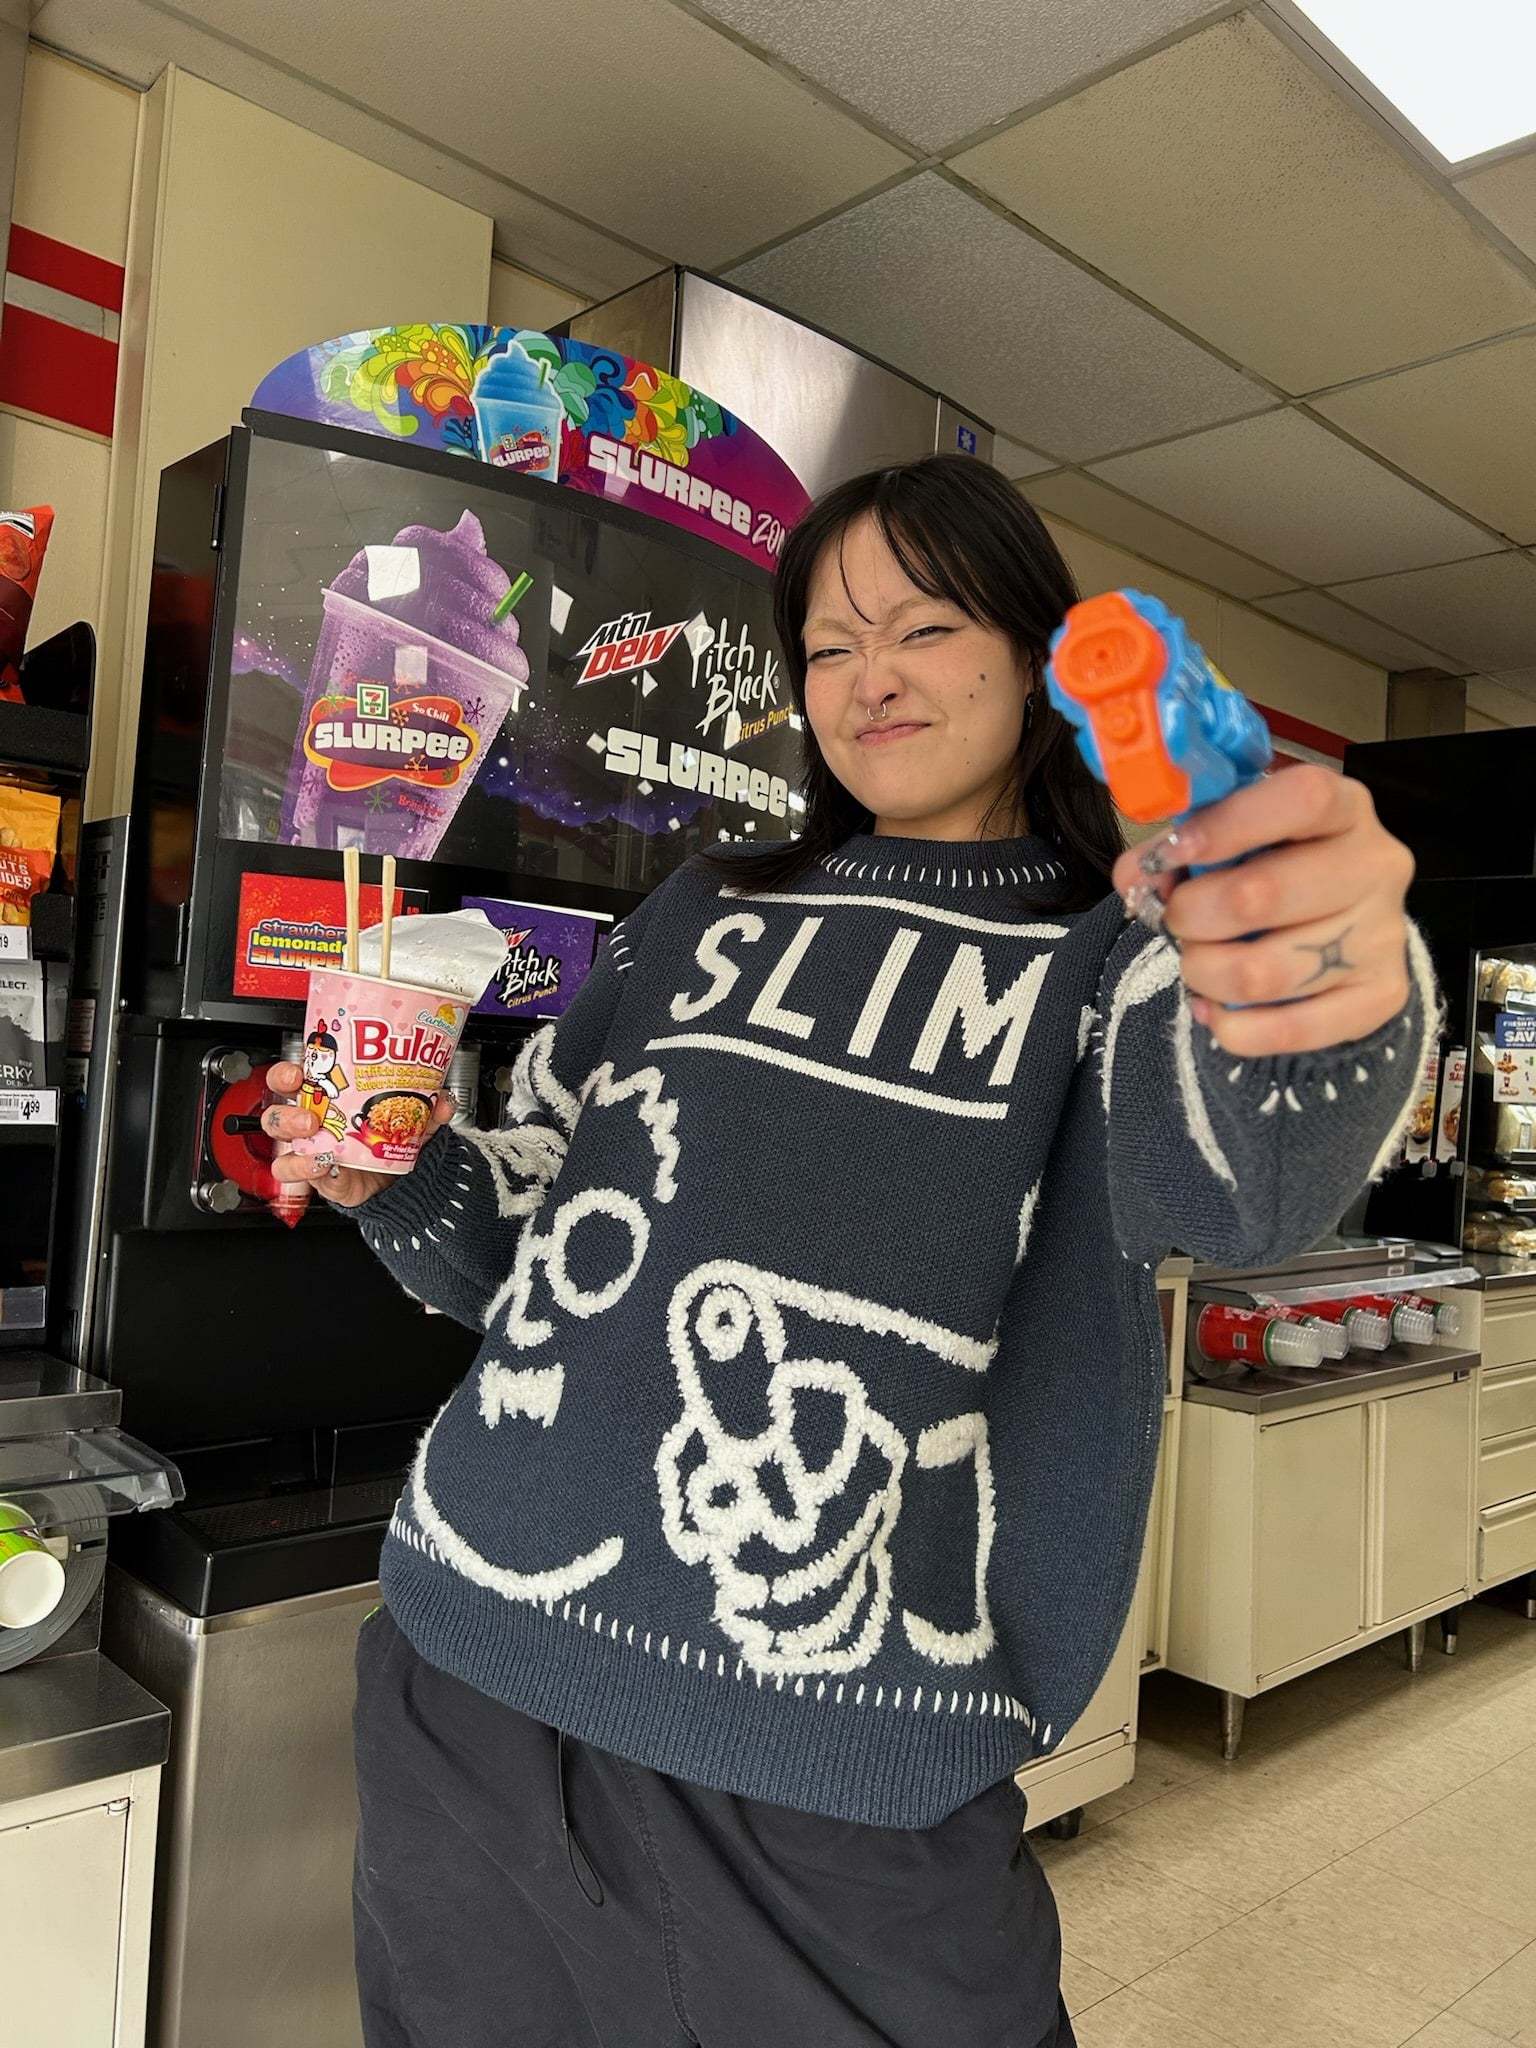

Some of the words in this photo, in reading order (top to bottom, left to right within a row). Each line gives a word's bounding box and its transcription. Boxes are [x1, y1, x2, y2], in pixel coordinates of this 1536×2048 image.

[689, 617, 755, 688] Pitch
[695, 650, 779, 737] Black
[426, 707, 450, 723] Chill
[738, 717, 766, 742] itrus
[261, 921, 348, 941] strawber
[498, 958, 561, 1001] Black
[507, 995, 532, 1009] Citrus
[533, 985, 558, 1001] Punch
[669, 912, 1055, 1086] SLIM
[1503, 1030, 1536, 1043] SAV
